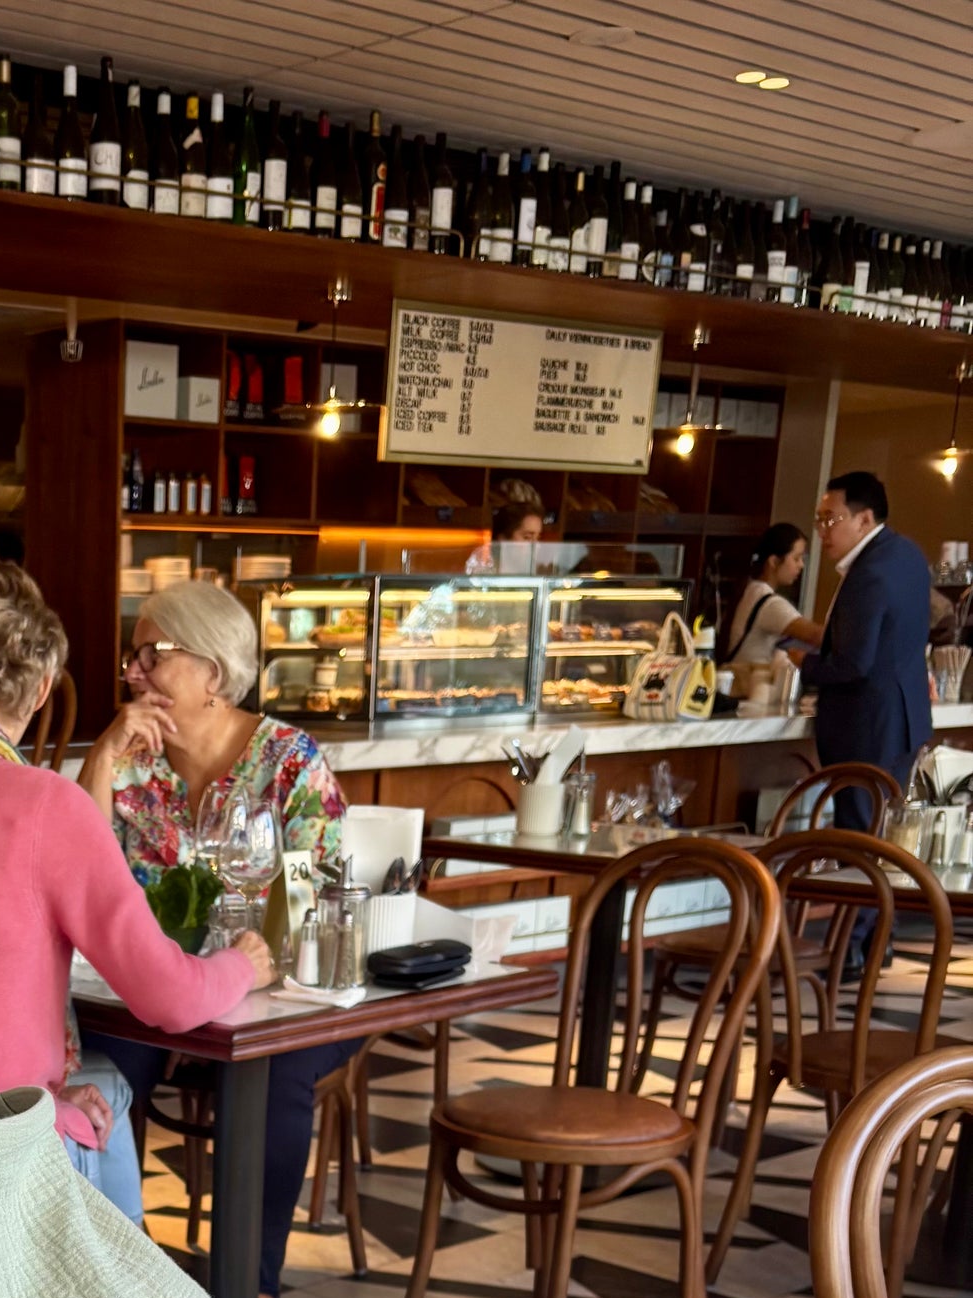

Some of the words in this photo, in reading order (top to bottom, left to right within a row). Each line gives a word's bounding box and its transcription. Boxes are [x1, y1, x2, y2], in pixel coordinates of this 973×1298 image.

[402, 313, 429, 326] BLACK
[431, 316, 459, 330] COFFEE
[402, 325, 420, 336] MILK
[430, 328, 458, 341] COFFEE
[546, 330, 567, 341] DAILY
[400, 349, 437, 361] PICCOLO
[399, 360, 415, 371] HOT
[416, 362, 441, 373] CHOC
[540, 358, 568, 370] QUICHE
[397, 387, 412, 396] ALT
[416, 388, 437, 398] MILK
[538, 383, 567, 393] CROQUE
[570, 386, 605, 397] MONSIEUR
[395, 398, 421, 408] DECAF
[395, 409, 414, 419] ICED
[417, 411, 447, 422] COFFEE
[535, 408, 569, 419] BAGUETTE
[584, 412, 619, 423] SANDWICH
[394, 420, 413, 430] ICED
[417, 422, 433, 432] TEA
[534, 421, 565, 432] SAUSAGE
[568, 424, 587, 434] ROLL
[289, 861, 309, 882] 20
